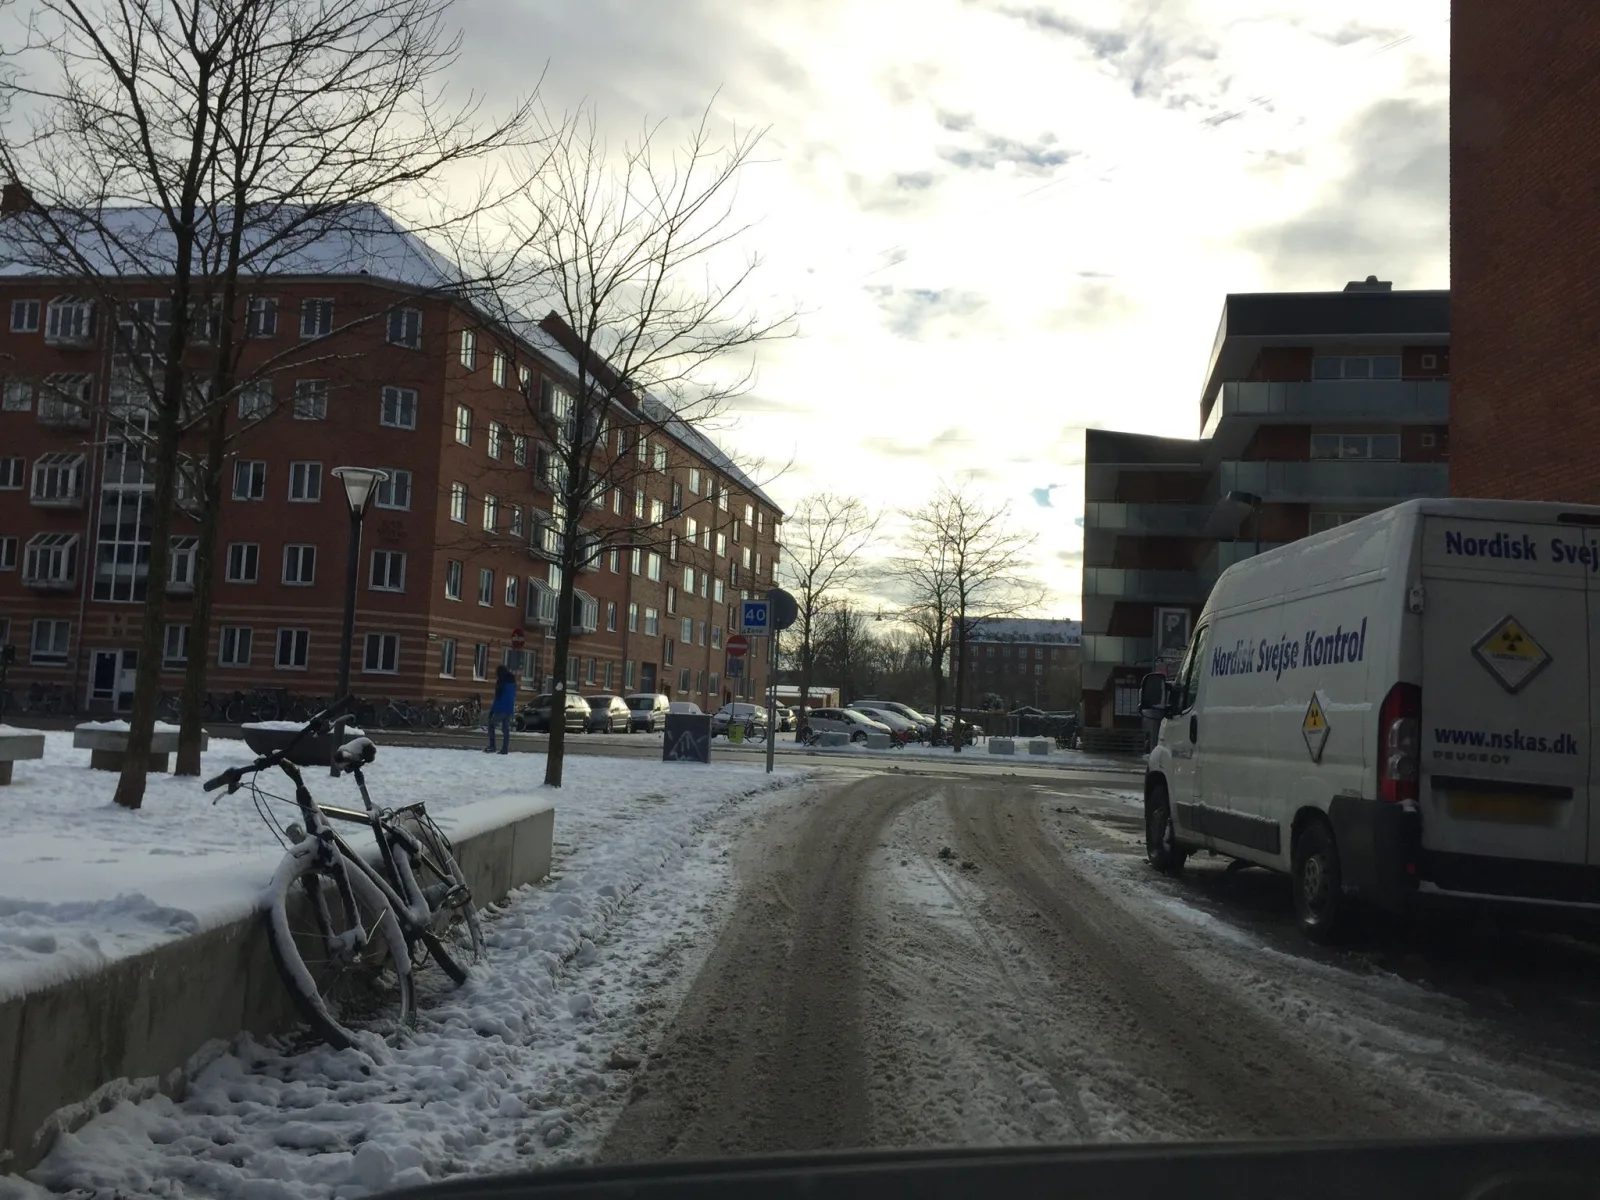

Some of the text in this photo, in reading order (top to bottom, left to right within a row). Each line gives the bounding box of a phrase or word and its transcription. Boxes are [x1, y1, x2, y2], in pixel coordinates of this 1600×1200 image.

[1445, 530, 1537, 561] Nordisk
[745, 609, 766, 621] 40
[1211, 616, 1368, 682] Nordisk Svejse Kontrol
[1434, 728, 1578, 755] www.nskas.dk
[1432, 750, 1511, 765] PEUGEOT
